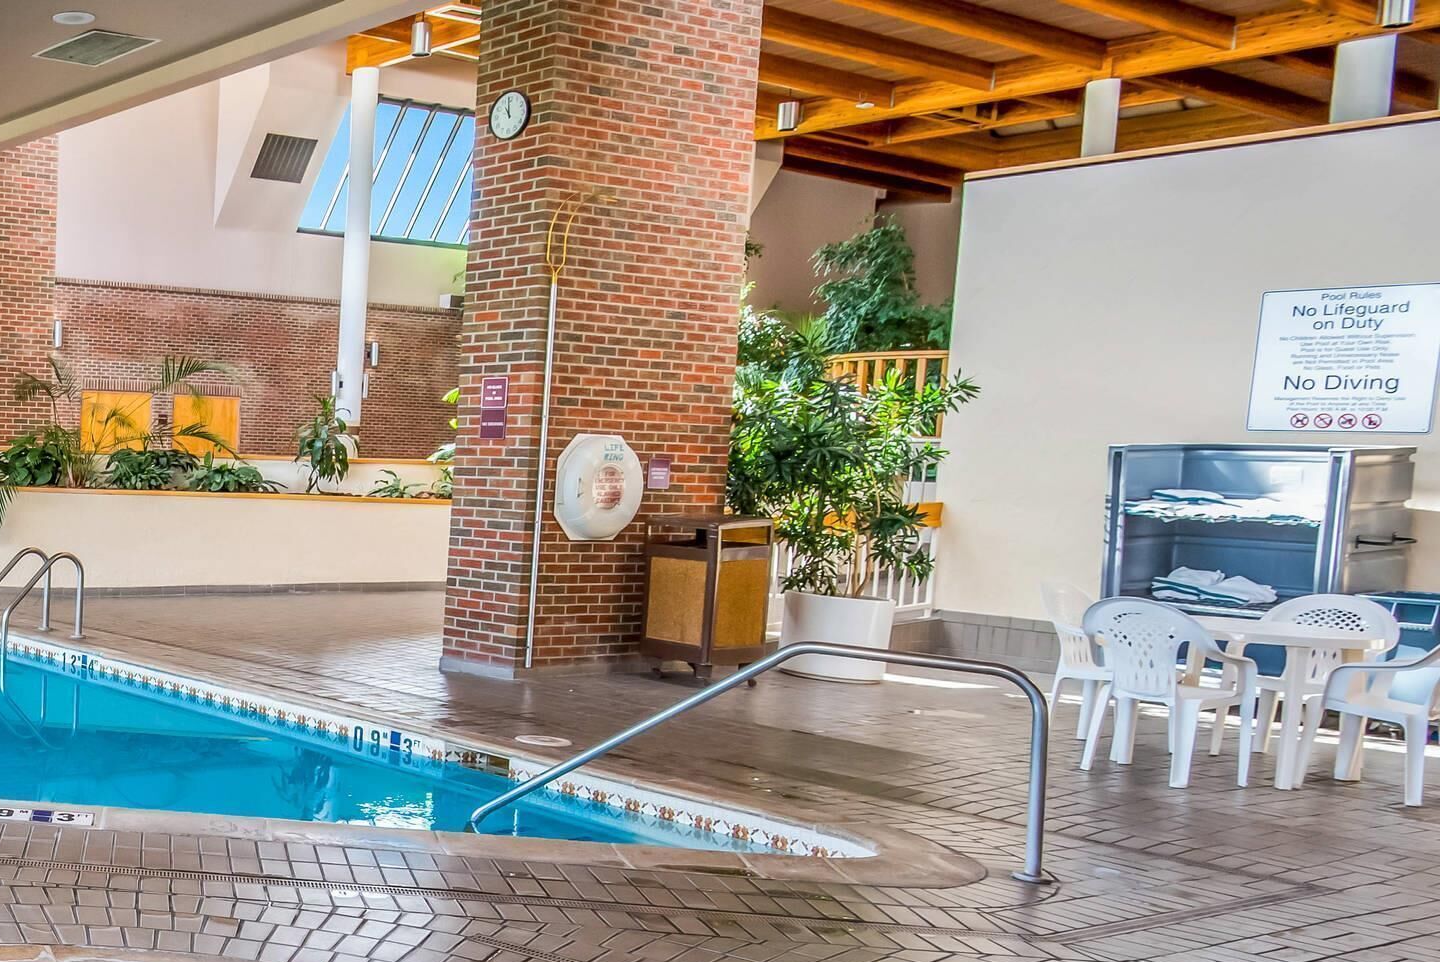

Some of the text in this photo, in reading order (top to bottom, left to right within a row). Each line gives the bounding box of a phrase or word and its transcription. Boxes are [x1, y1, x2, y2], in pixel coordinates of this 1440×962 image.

[1321, 291, 1382, 301] Pool Rules
[1292, 301, 1410, 317] No Lifeguard
[1312, 317, 1384, 331] on Duty
[1283, 374, 1400, 394] No Diving
